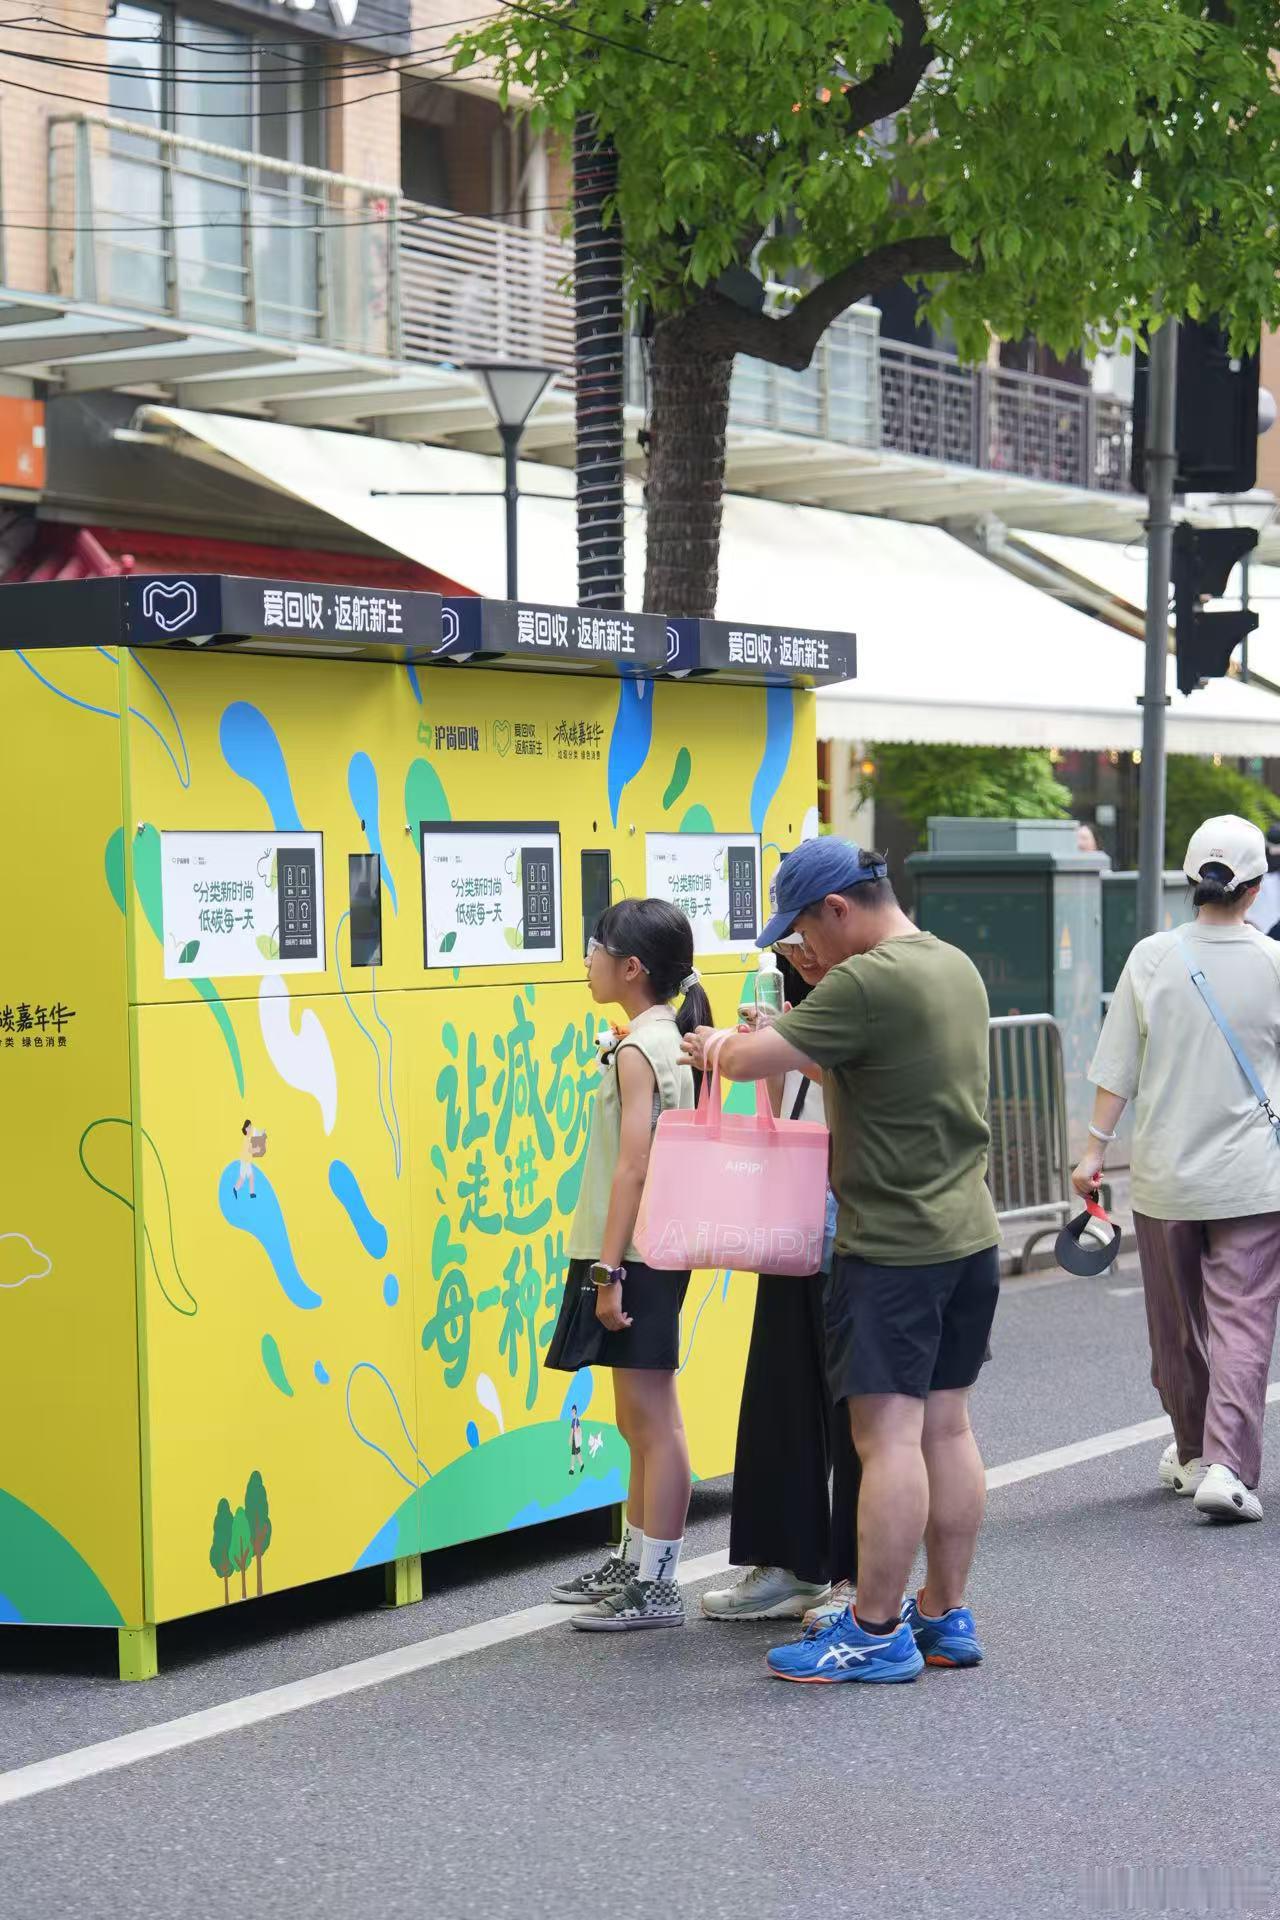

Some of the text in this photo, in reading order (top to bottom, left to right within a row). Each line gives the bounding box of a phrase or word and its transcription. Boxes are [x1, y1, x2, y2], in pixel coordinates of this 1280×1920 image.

[263, 589, 404, 634] 爱回收·返航新生
[517, 610, 636, 653] 爱回收·返航新生
[728, 631, 830, 670] 爱回收·返航新生
[434, 725, 480, 752] 沪尚回收
[514, 723, 536, 738] 爱回收
[552, 719, 605, 748] 减碳嘉年华
[193, 879, 255, 903] 分类新时尚
[451, 876, 503, 898] 分类新时尚
[668, 873, 712, 893] 分类新时尚
[198, 907, 255, 934] 低碳每一天
[455, 902, 503, 926] 低碳每一天
[22, 1036, 67, 1048] 绿色消费
[457, 1134, 552, 1236] 走进
